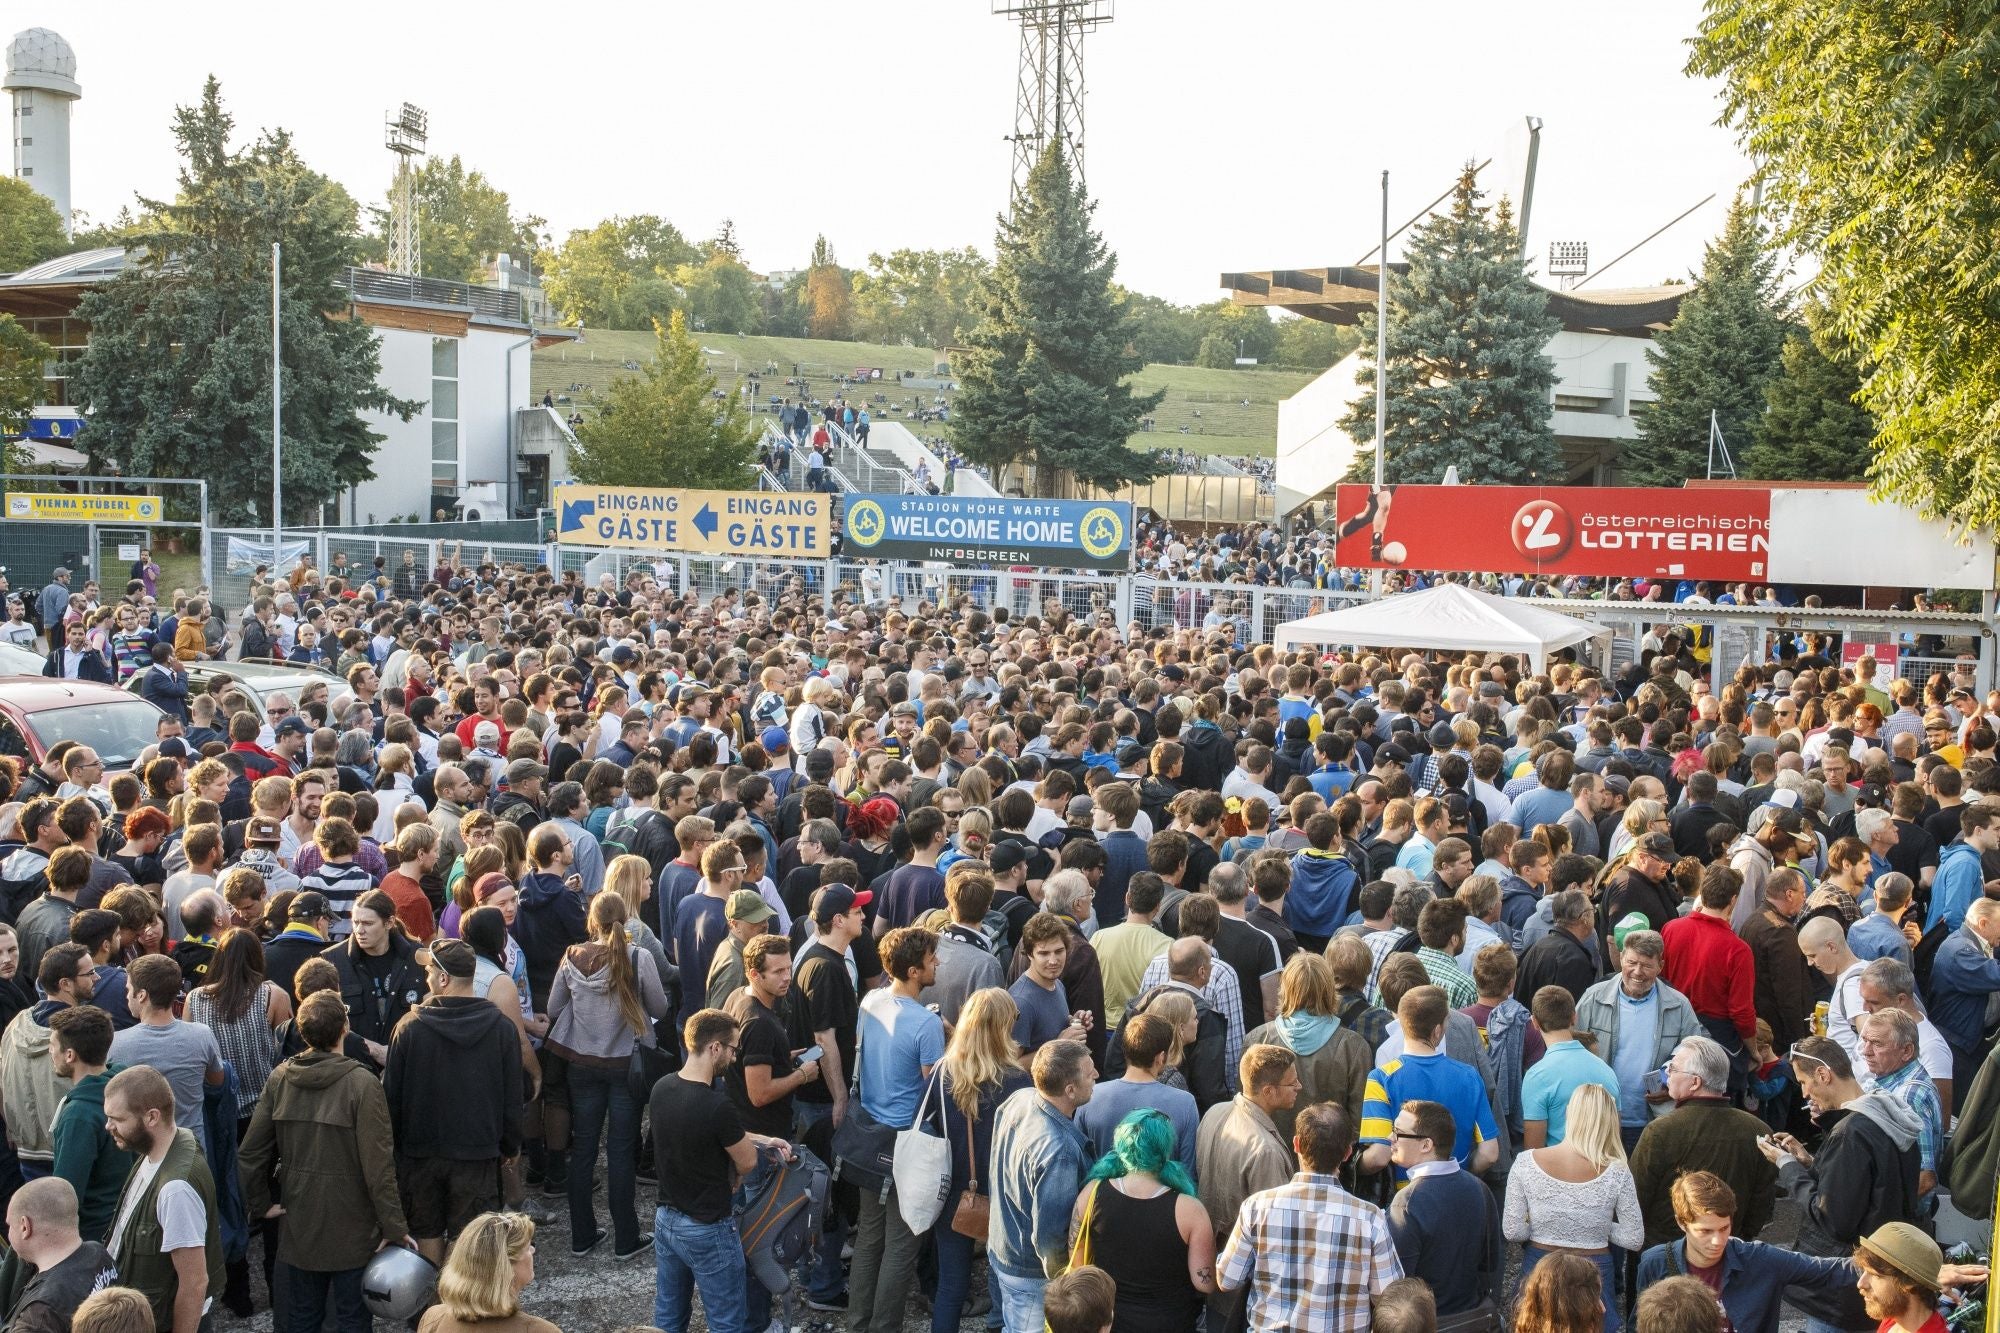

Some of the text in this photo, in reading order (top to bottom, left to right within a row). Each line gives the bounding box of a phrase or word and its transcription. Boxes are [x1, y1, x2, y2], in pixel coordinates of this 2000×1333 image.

[35, 497, 130, 510] VIENNA STÜBERL
[598, 494, 678, 512] EINGANG
[727, 498, 817, 516] EINGANG
[901, 501, 1060, 516] STADION HOHE WARTE
[598, 512, 677, 542] GÄSTE
[727, 518, 816, 549] GÄSTE
[890, 515, 1000, 540] WELCOME
[1007, 520, 1074, 543] HOME
[1581, 531, 1769, 552] LOTTERIEN
[929, 547, 1030, 562] INFOSCREEN
